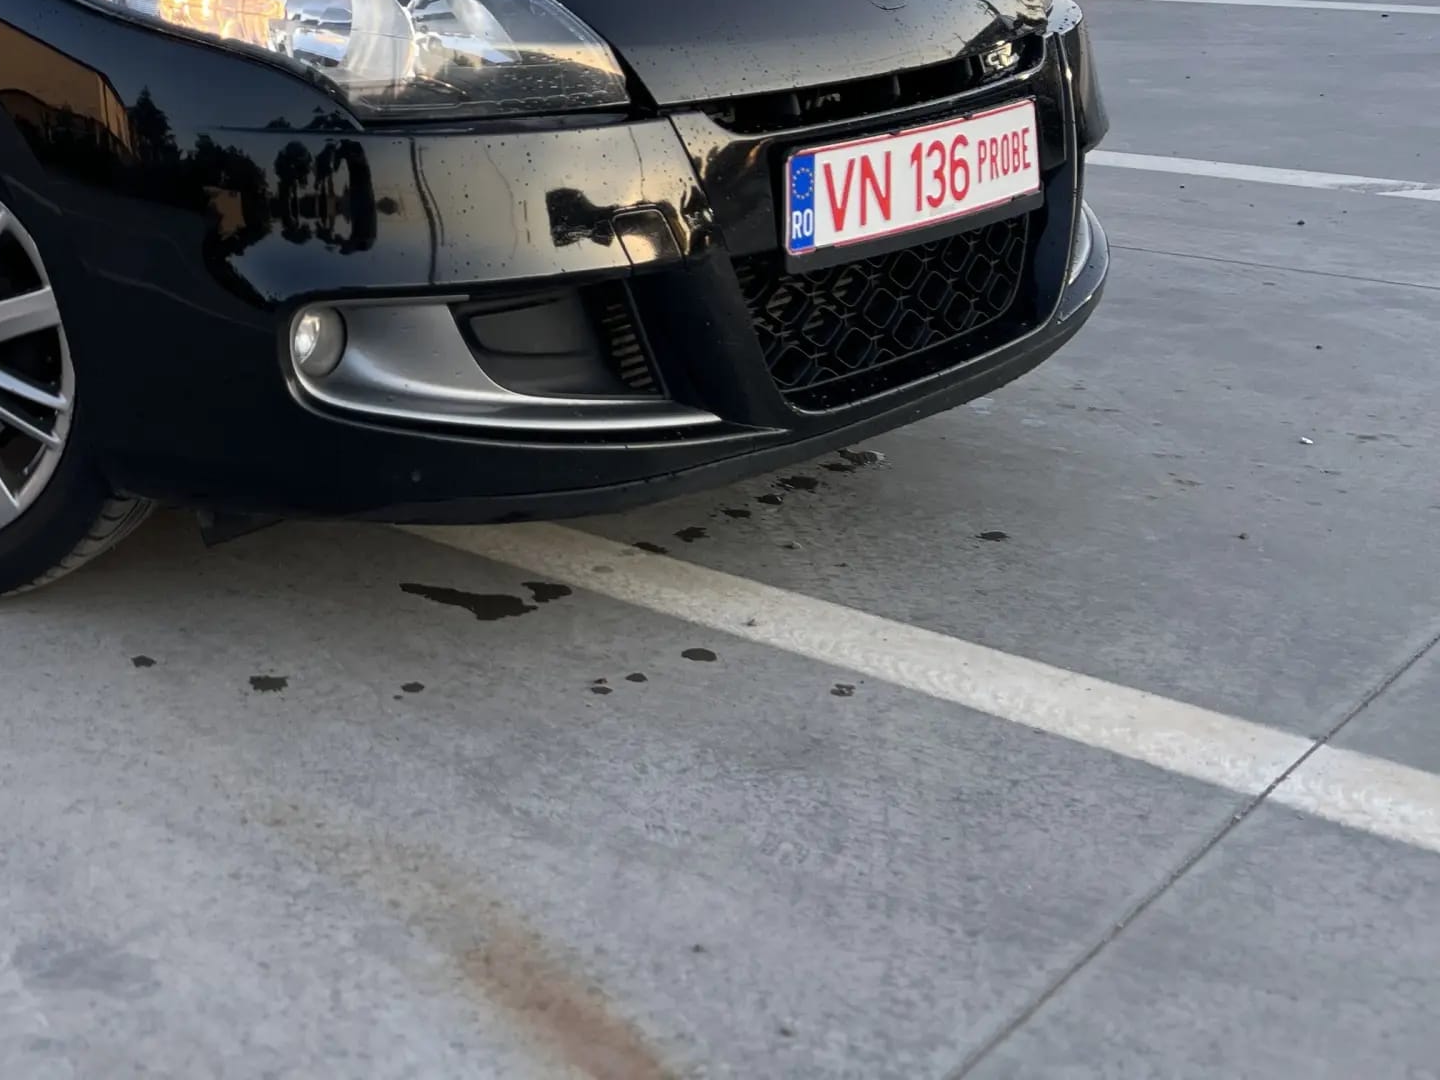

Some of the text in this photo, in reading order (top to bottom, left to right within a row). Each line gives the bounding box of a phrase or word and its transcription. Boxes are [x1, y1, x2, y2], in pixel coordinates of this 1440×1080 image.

[823, 127, 1032, 232] VN 136 PROBE
[791, 208, 814, 240] RO
